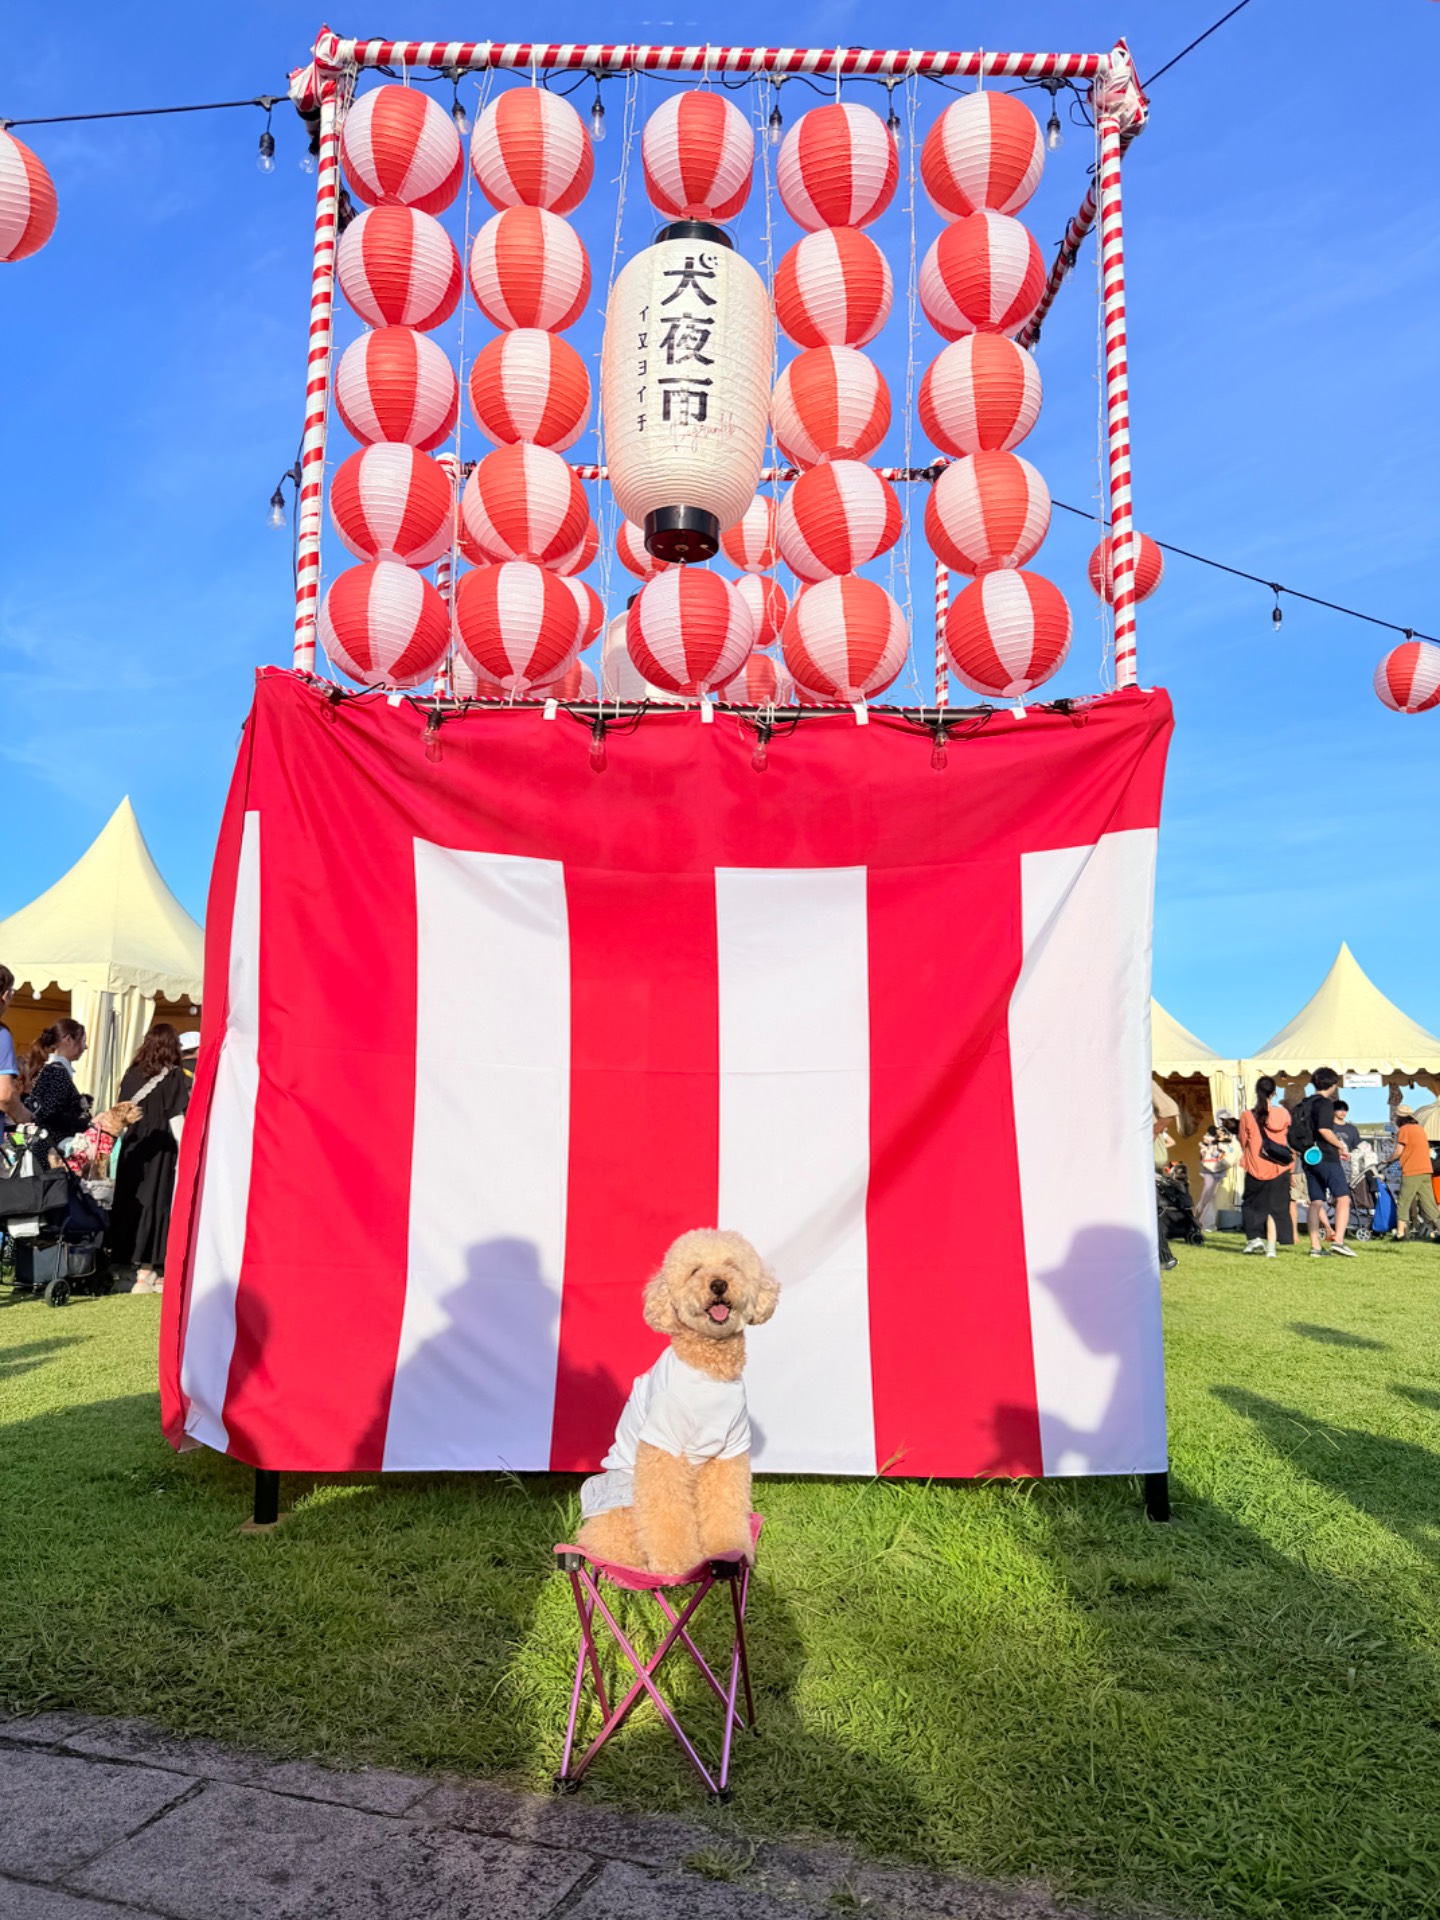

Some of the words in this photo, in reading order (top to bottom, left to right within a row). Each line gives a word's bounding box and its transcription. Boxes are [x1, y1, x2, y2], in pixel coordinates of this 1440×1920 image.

[637, 306, 649, 432] イヌヨイチ
[658, 253, 718, 426] 犬夜市
